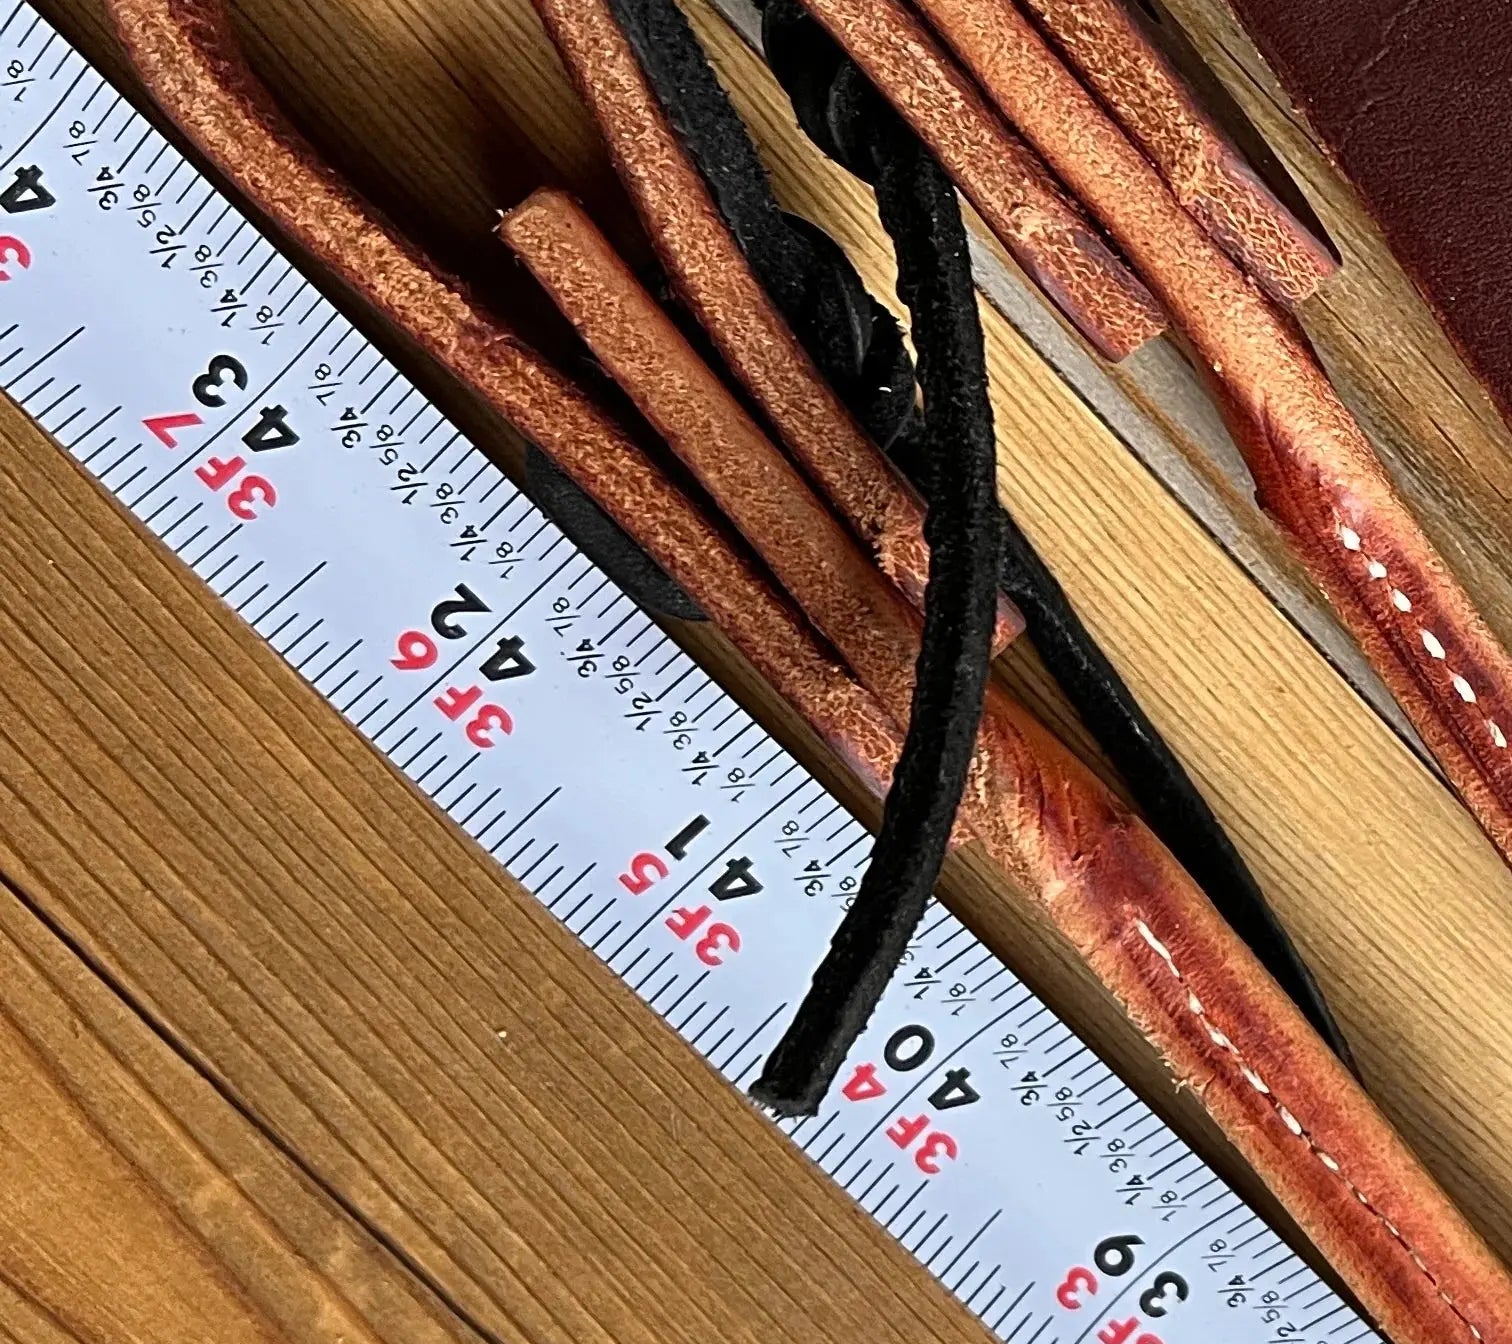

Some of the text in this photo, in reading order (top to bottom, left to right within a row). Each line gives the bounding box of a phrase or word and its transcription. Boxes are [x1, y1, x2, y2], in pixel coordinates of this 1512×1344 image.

[1, 60, 36, 102] 1/8
[63, 121, 284, 345] 1/8 1/4 3/8 1/2 5/8 3/4 7/8
[192, 355, 300, 452] 43
[142, 414, 203, 448] 7
[308, 363, 524, 579] 1/8 1/4 3/8 1/2 5/8 3/4 7/8
[391, 631, 438, 670] 6
[431, 583, 536, 681] 42
[545, 597, 755, 803] 1/8 1/4 3/8 1/2 5/8 3/4 7/8
[664, 814, 763, 901] 41
[774, 820, 809, 858] 7/8
[619, 853, 668, 895] 5
[794, 860, 831, 897] 3/4
[904, 967, 941, 1000] 1/4
[941, 983, 976, 1016] 1/8
[842, 1064, 886, 1101] 4
[884, 1025, 981, 1110] 40
[993, 1034, 1187, 1221] 1/8 1/4 3/8 1/2 5/8 3/4 7/8
[1094, 1235, 1189, 1318] 39
[1201, 1239, 1235, 1272] 7/8
[1057, 1267, 1097, 1310] 3
[1218, 1275, 1254, 1308] 3/4
[1253, 1291, 1288, 1323] 5/8
